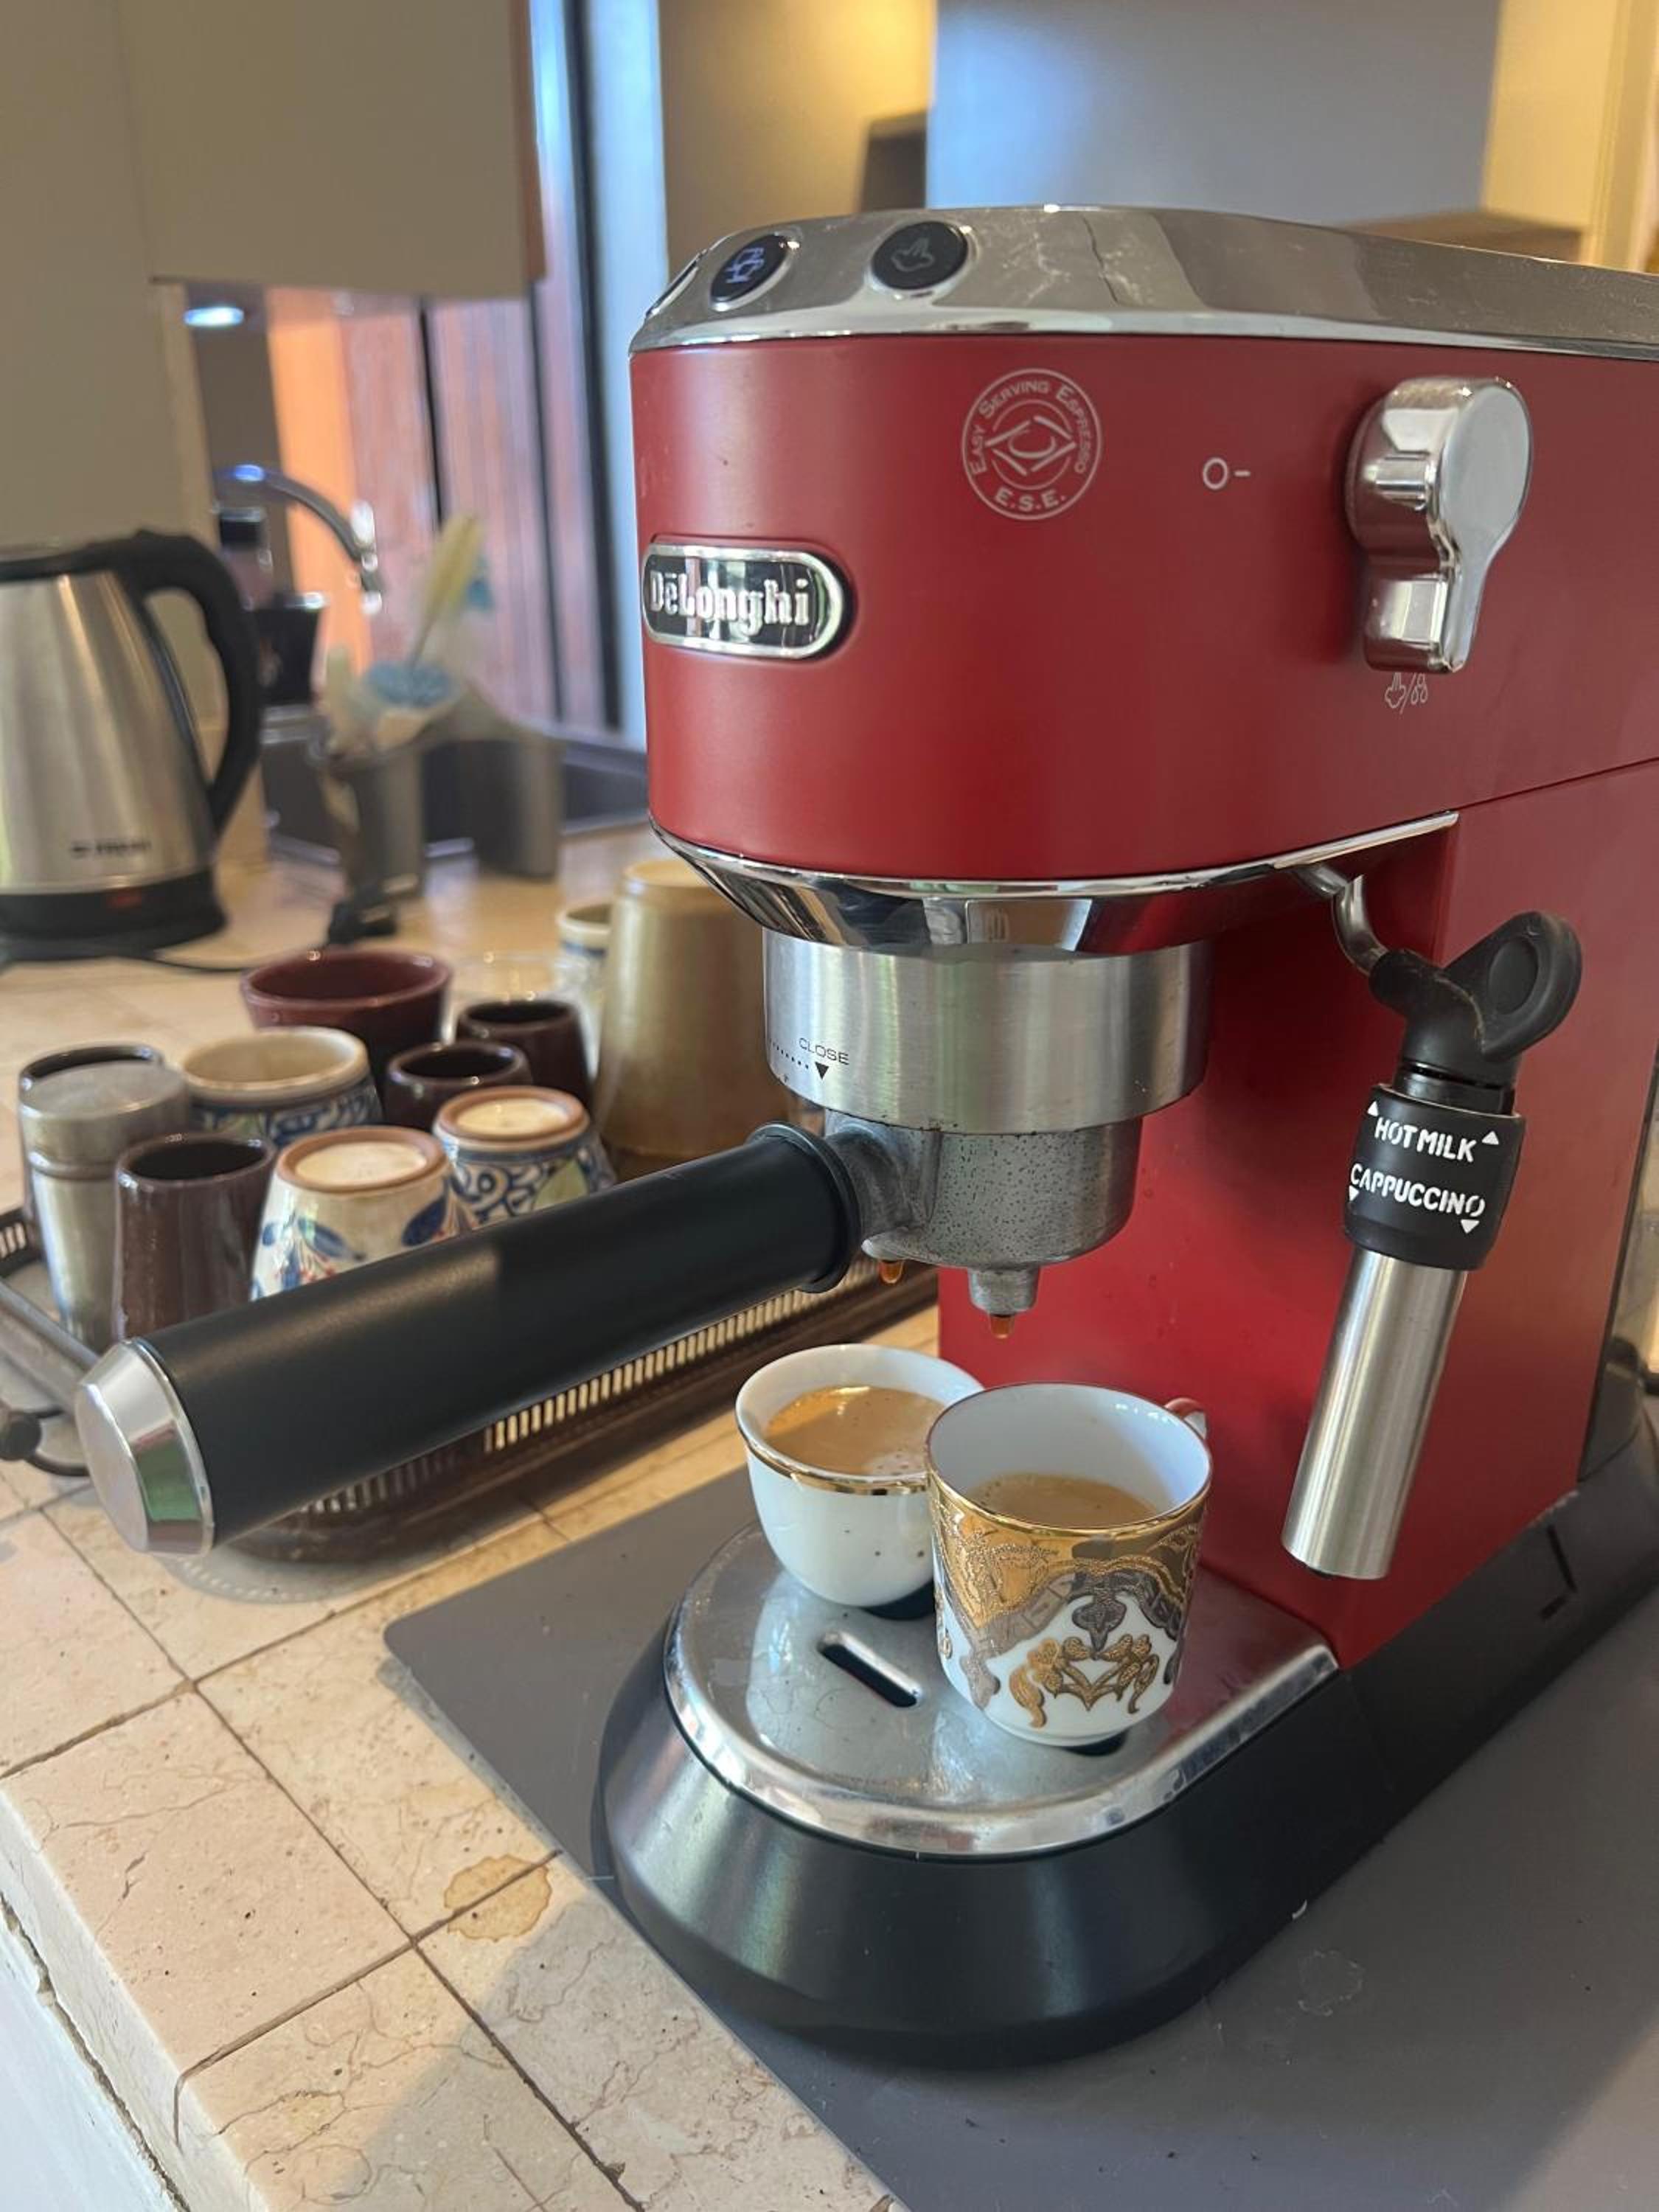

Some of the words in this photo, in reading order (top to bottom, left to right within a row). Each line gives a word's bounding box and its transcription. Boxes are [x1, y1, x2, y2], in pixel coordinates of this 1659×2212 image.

[969, 425, 987, 476] EASY
[978, 380, 1048, 418] SERVING
[1056, 384, 1091, 474] ESPRESSO
[799, 1037, 849, 1065] CLOSE
[1374, 1117, 1418, 1148] HOT
[1416, 1129, 1476, 1162] MILK
[1351, 1164, 1486, 1217] CAPPUCCINO
